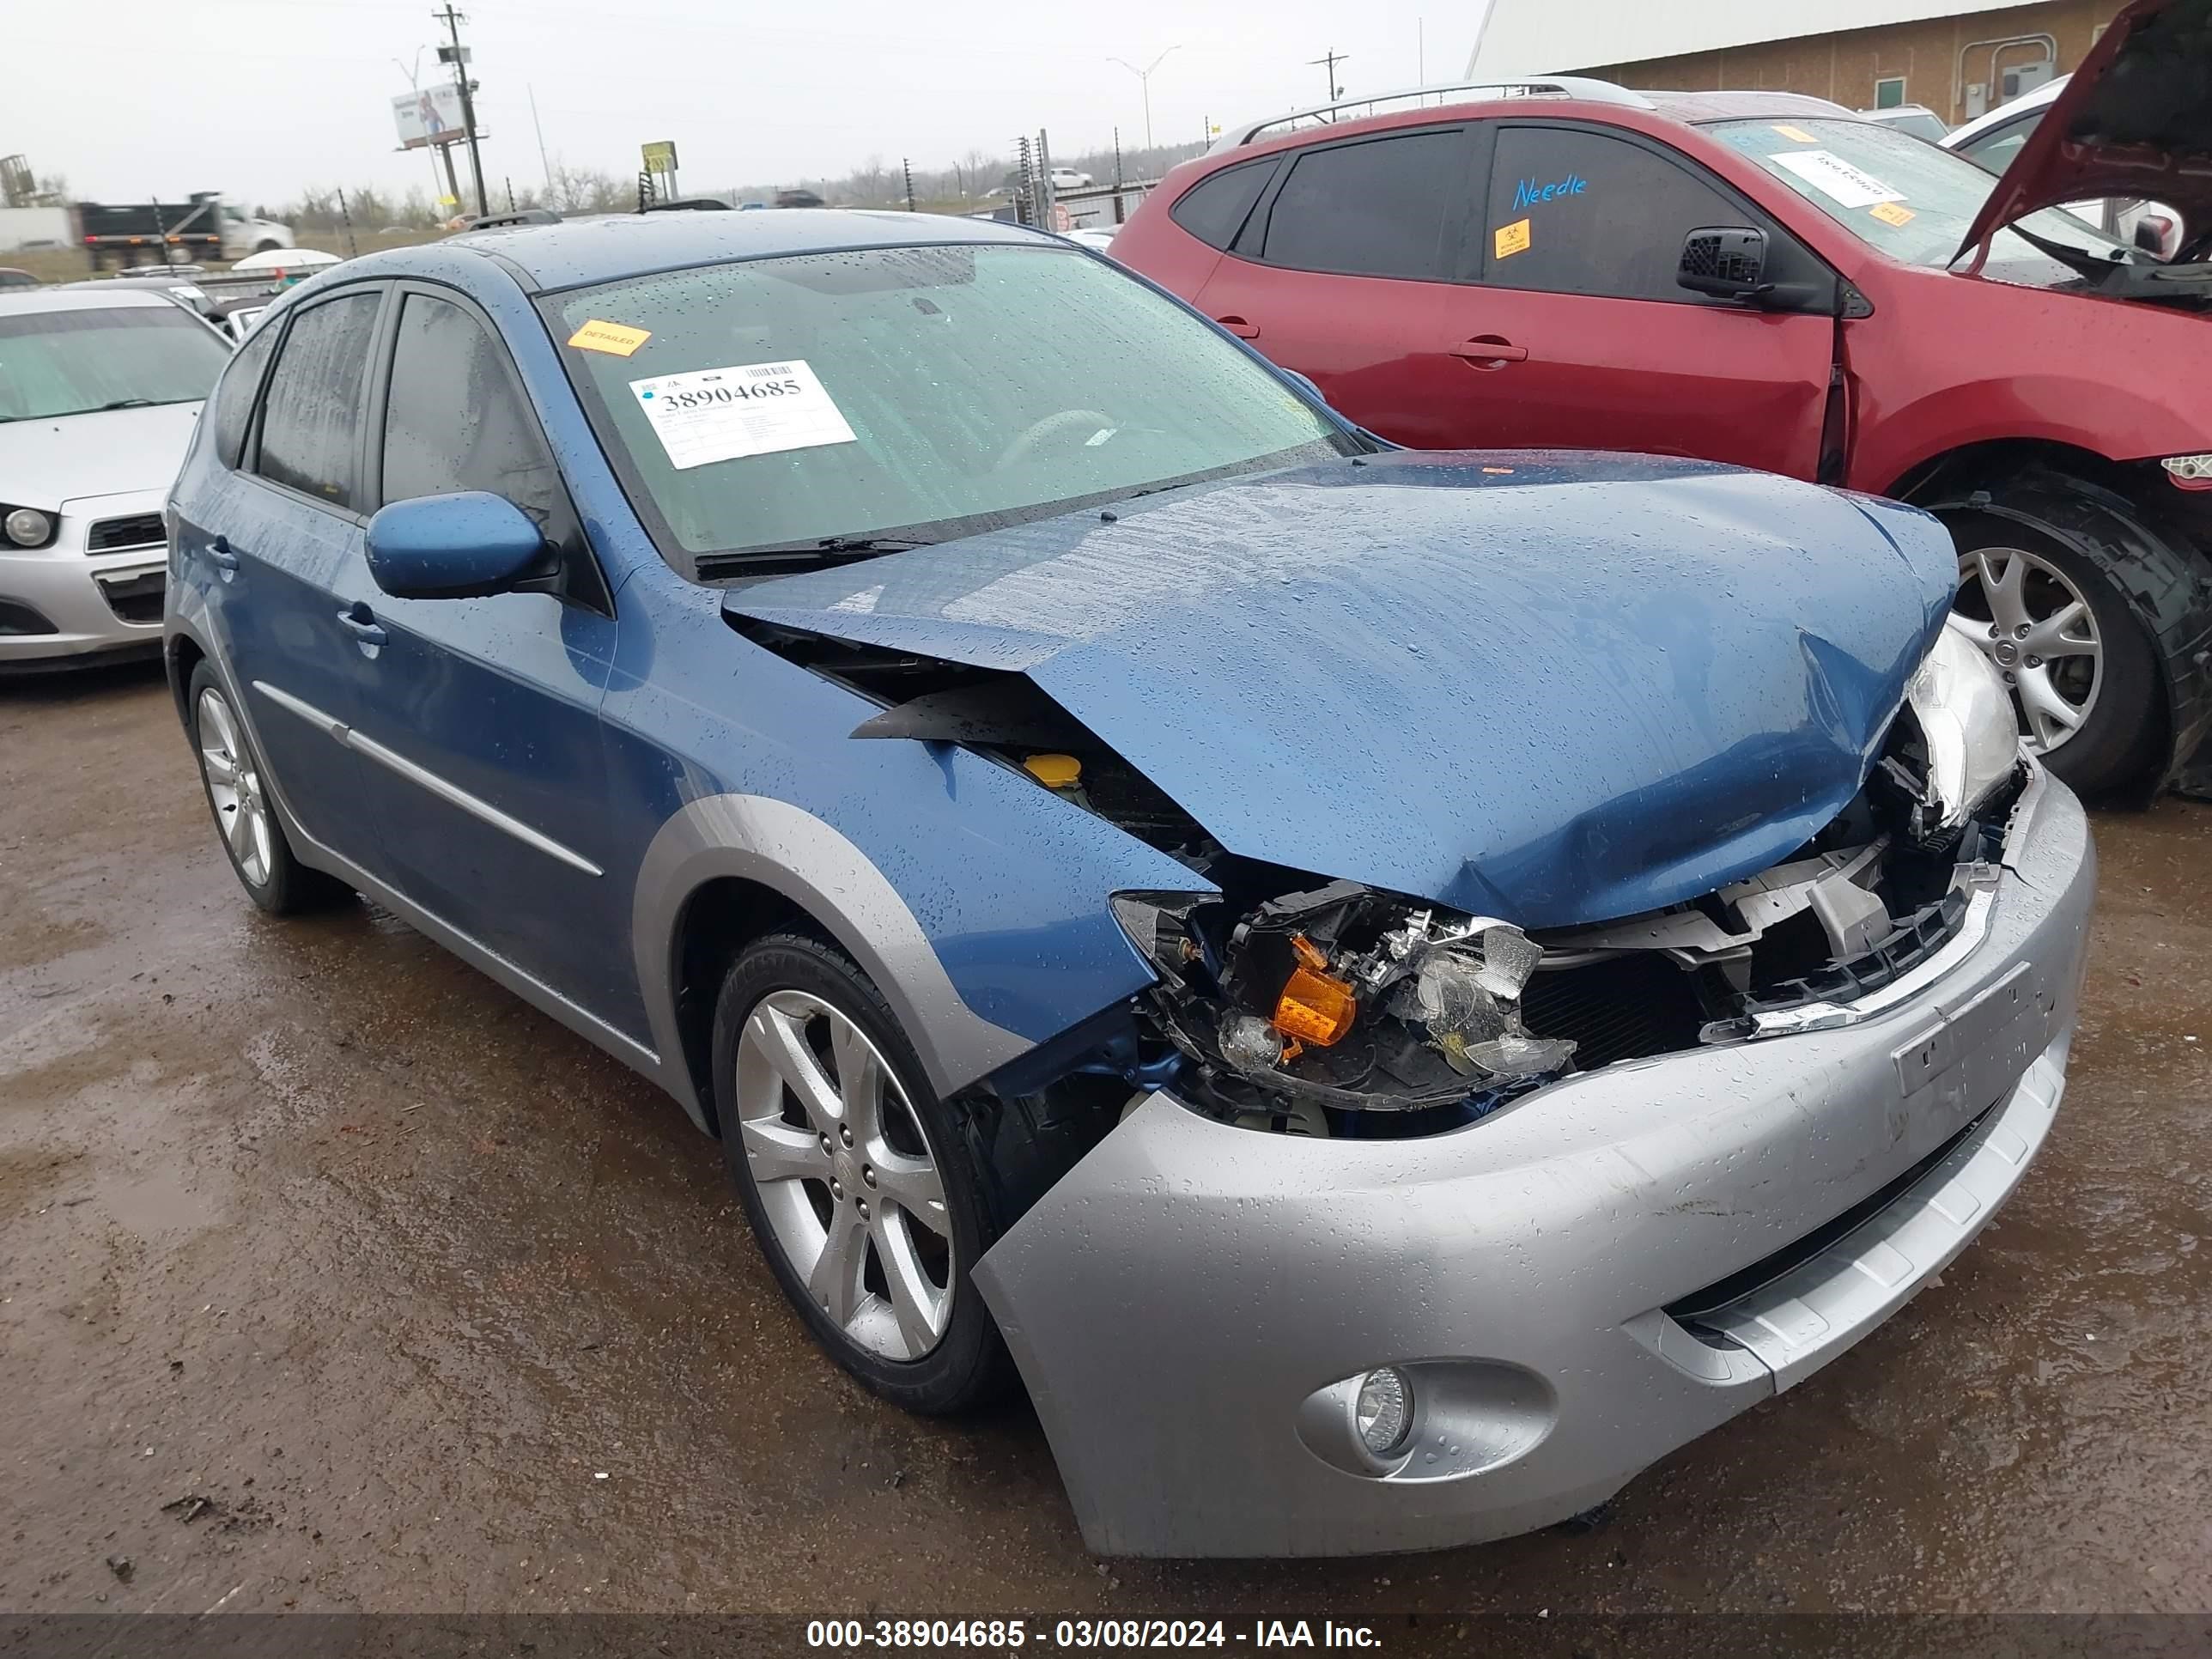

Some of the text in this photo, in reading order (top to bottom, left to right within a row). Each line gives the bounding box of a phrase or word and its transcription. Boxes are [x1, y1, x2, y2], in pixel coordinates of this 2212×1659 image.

[1512, 172, 1588, 211] Needle
[583, 330, 635, 345] DETAILED
[660, 380, 802, 412] 38904685
